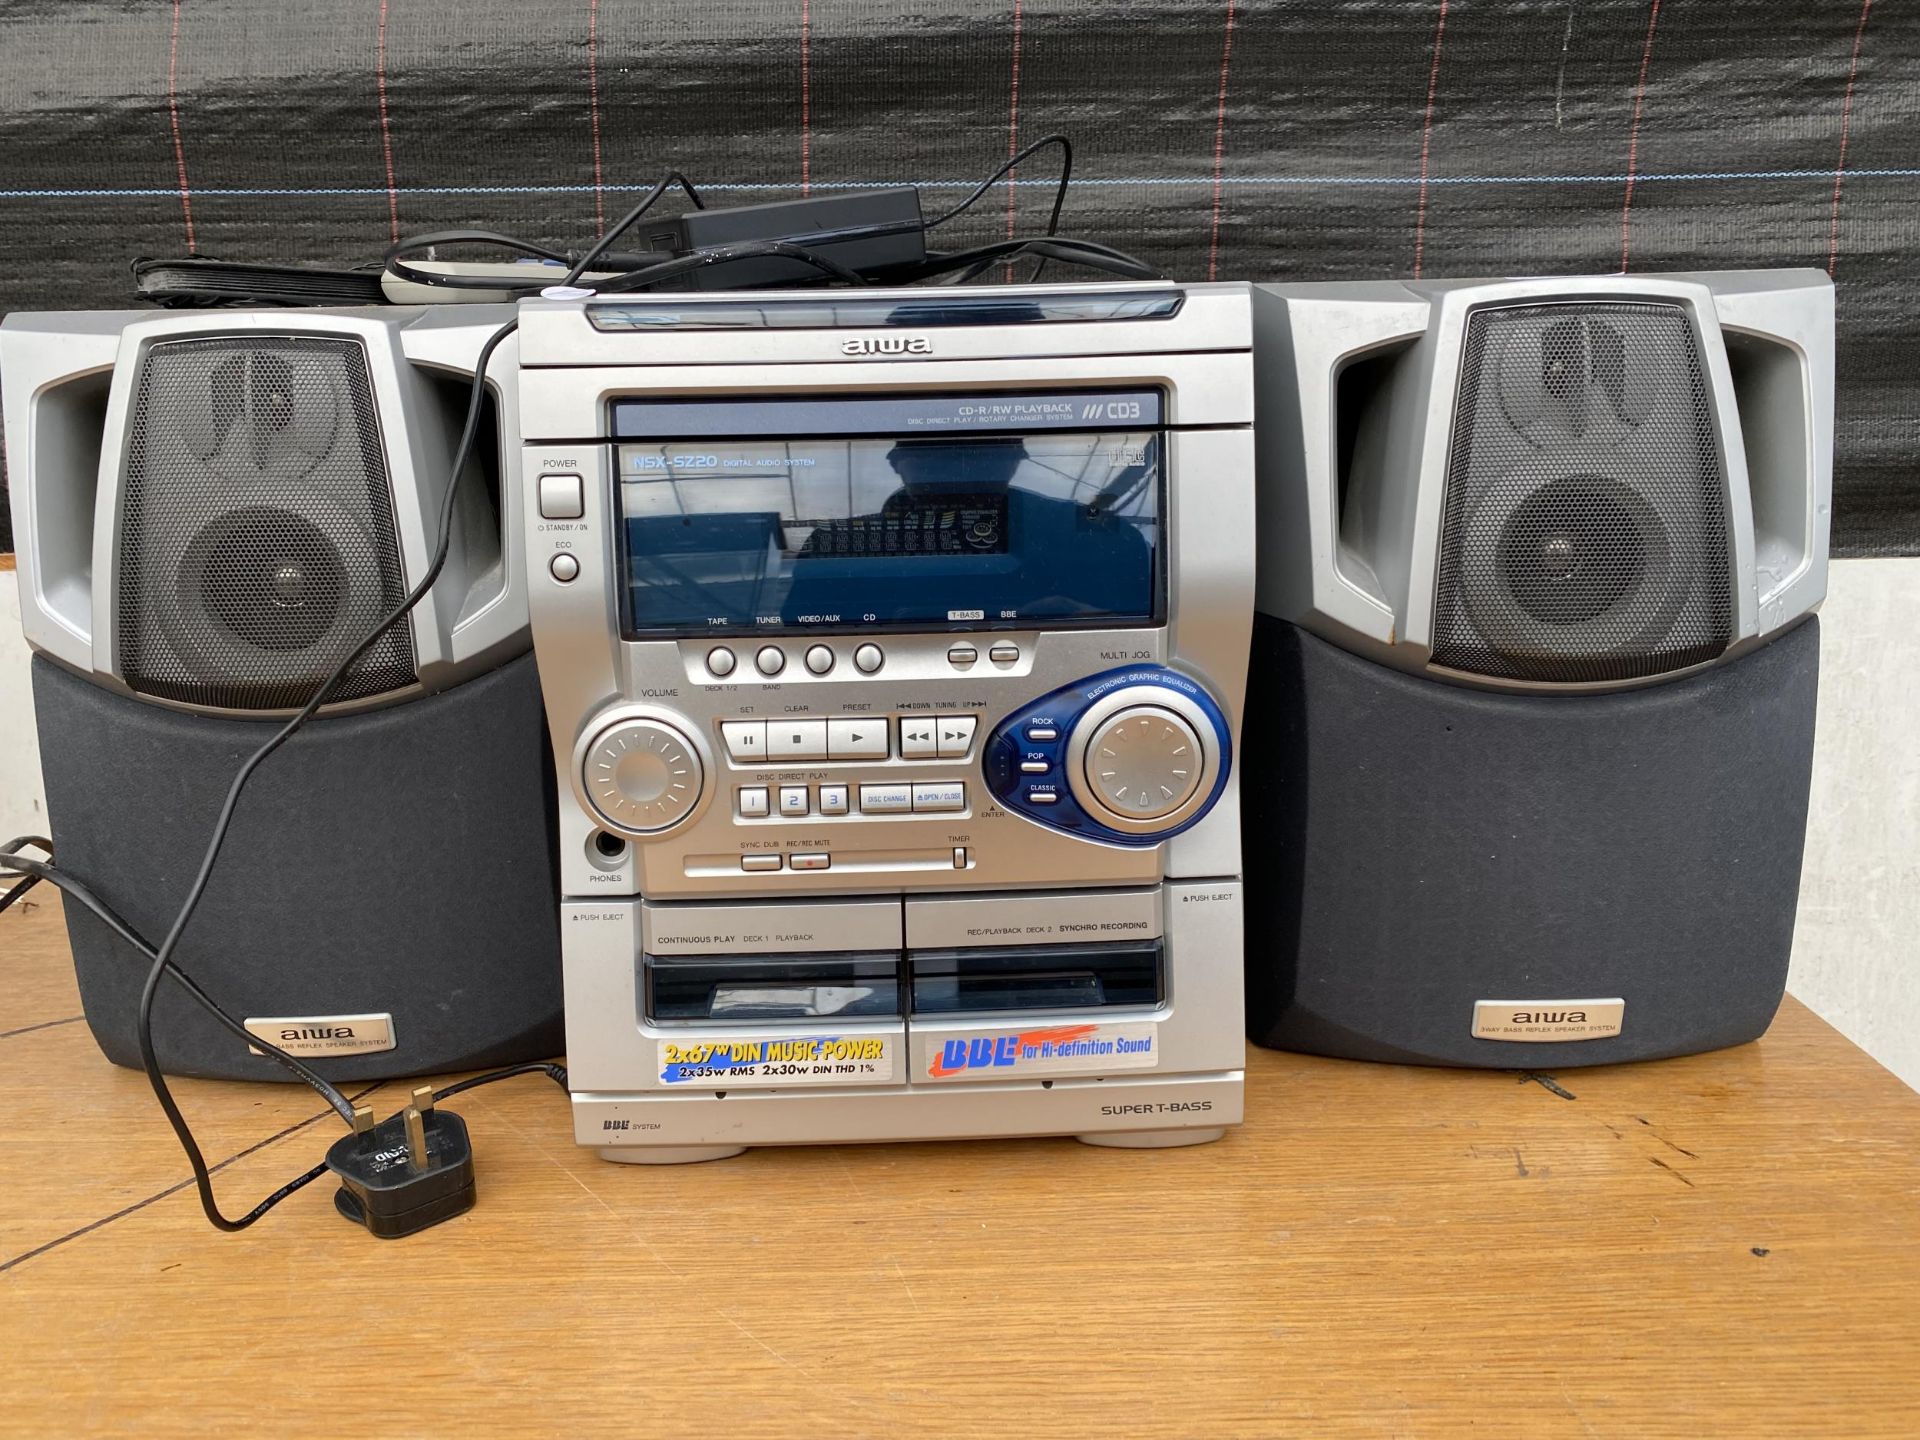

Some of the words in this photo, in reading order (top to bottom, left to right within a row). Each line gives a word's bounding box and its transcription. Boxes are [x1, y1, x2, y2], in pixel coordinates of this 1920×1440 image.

[841, 335, 933, 355] aiwa
[958, 405, 1012, 416] CD-R/RW
[1014, 403, 1072, 414] PLAYBACK
[1106, 402, 1141, 419] CD3
[926, 417, 950, 425] DIRECT
[953, 416, 972, 425] PLAY
[979, 416, 1006, 424] ROTARY
[1010, 414, 1043, 422] CHANGER
[1046, 413, 1073, 421] SYSTEM
[543, 459, 577, 469] POWER
[633, 455, 718, 468] NSX-SZ20
[723, 459, 753, 467] DIGITAL
[756, 459, 780, 467] AUDIO
[784, 458, 816, 467] SYSTEM
[555, 541, 572, 549] ECO
[797, 614, 841, 624] VIDEO/AUX
[863, 612, 876, 622] CD
[951, 611, 981, 620] T-BASS
[1000, 610, 1017, 619] BBE
[707, 617, 728, 626] TAPE
[755, 616, 781, 625] TUNER
[1100, 651, 1127, 660] MULTI
[1132, 650, 1151, 659] JOG
[705, 684, 721, 692] DECK
[726, 684, 738, 692] 1/2
[762, 683, 781, 691] BAND
[1087, 676, 1127, 700] ELECTRONIC
[1128, 673, 1160, 682] GRAPHIC
[1162, 675, 1197, 695] EQUALIZER
[641, 687, 679, 697] VOLUME
[740, 706, 754, 714] SET
[784, 705, 809, 713] CLEAR
[843, 703, 871, 711] PRESET
[1032, 717, 1054, 725] ROCK
[1027, 752, 1044, 760] POP
[756, 773, 775, 781] DISC
[778, 772, 805, 780] DIRECT
[809, 772, 828, 780] PLAY
[1030, 784, 1056, 792] CLASSIC
[789, 795, 799, 806] 2
[829, 794, 839, 806] 3
[867, 795, 882, 803] DISC
[883, 794, 907, 802] CHANGE
[923, 793, 939, 801] OPEN
[814, 839, 830, 847] MUTE
[948, 835, 970, 843] TIMER
[740, 841, 760, 849] SYNC
[589, 874, 622, 883] PHONES
[1190, 894, 1210, 902] PUSH
[1211, 893, 1232, 901] EJECT
[602, 913, 624, 921] EJECT
[967, 927, 1022, 936] REC/PLAYBACK
[1026, 926, 1045, 934] DECK
[1059, 924, 1098, 933] SYNCHRO
[1100, 921, 1148, 931] RECORDING
[657, 935, 712, 944] CONTINUOUS
[713, 934, 735, 944] PLAY
[743, 934, 763, 942] DECK
[775, 933, 814, 942] PLAYBACK
[1512, 1011, 1587, 1024] aiwa
[1588, 1024, 1616, 1032] SYSTEM
[280, 1027, 355, 1041] aiwa
[730, 1043, 762, 1063] DIN
[765, 1041, 818, 1062] MUSIC
[822, 1039, 884, 1061] POWER
[941, 1036, 1019, 1070] BBE
[1021, 1044, 1038, 1060] for
[1040, 1039, 1114, 1059] Hi-definition
[1116, 1036, 1152, 1055] Sound
[729, 1066, 756, 1077] RMS
[812, 1065, 832, 1074] DIN
[834, 1064, 856, 1074] THD
[858, 1063, 876, 1073] 1%
[1101, 1104, 1153, 1116] SUPER
[1157, 1101, 1212, 1113] T-BASS
[603, 1120, 630, 1130] BBE
